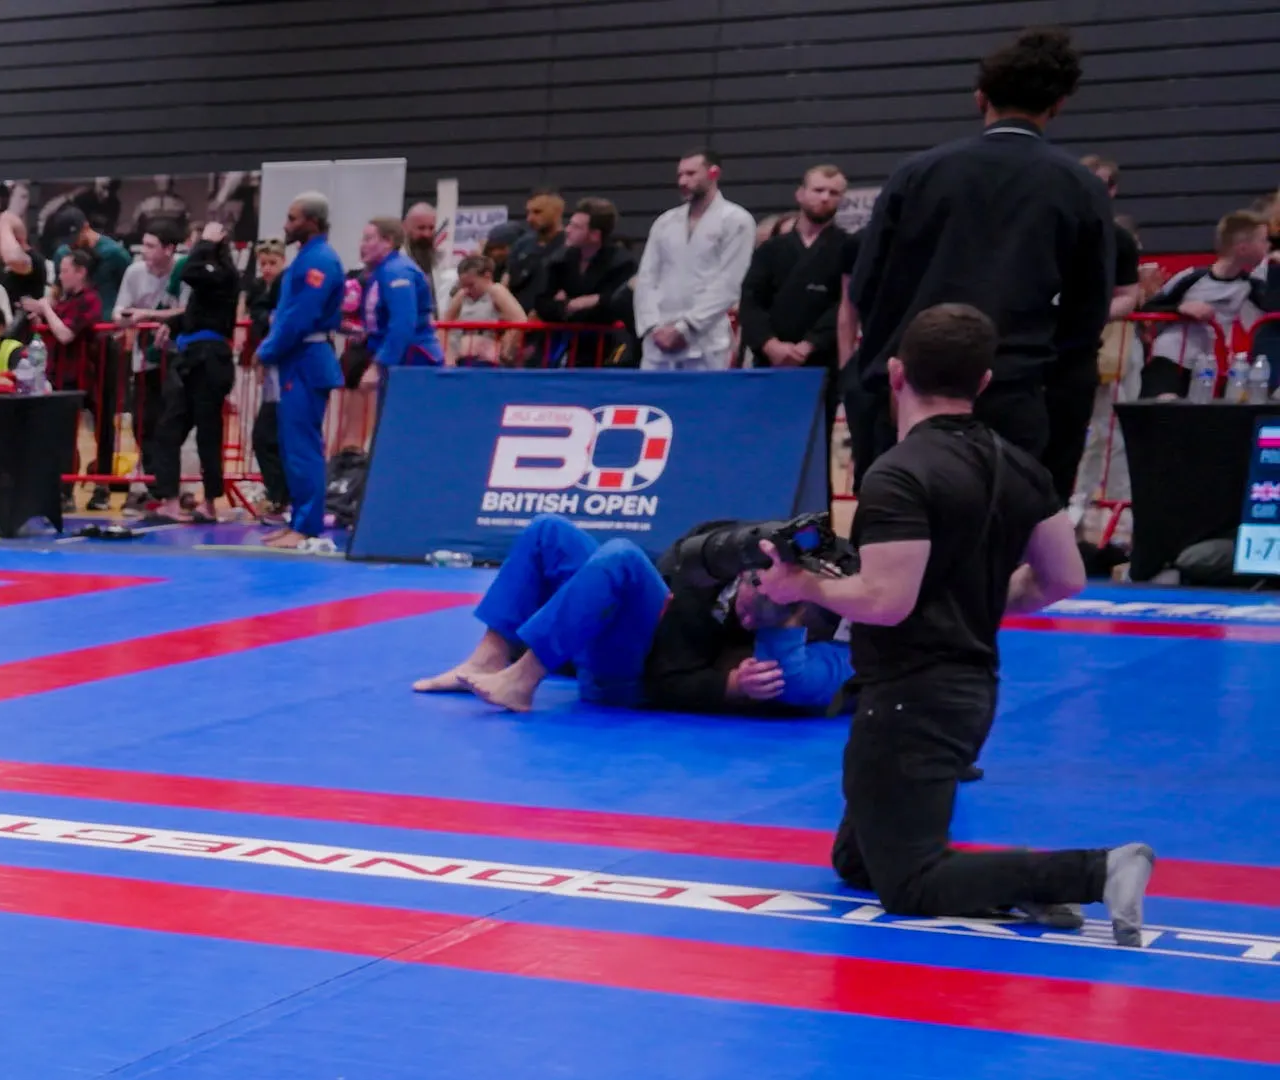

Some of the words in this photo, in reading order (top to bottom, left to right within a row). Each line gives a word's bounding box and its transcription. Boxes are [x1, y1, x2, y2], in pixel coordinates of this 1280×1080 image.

[481, 491, 580, 514] BRITISH
[583, 494, 659, 517] OPEN
[1245, 537, 1280, 560] 1-7
